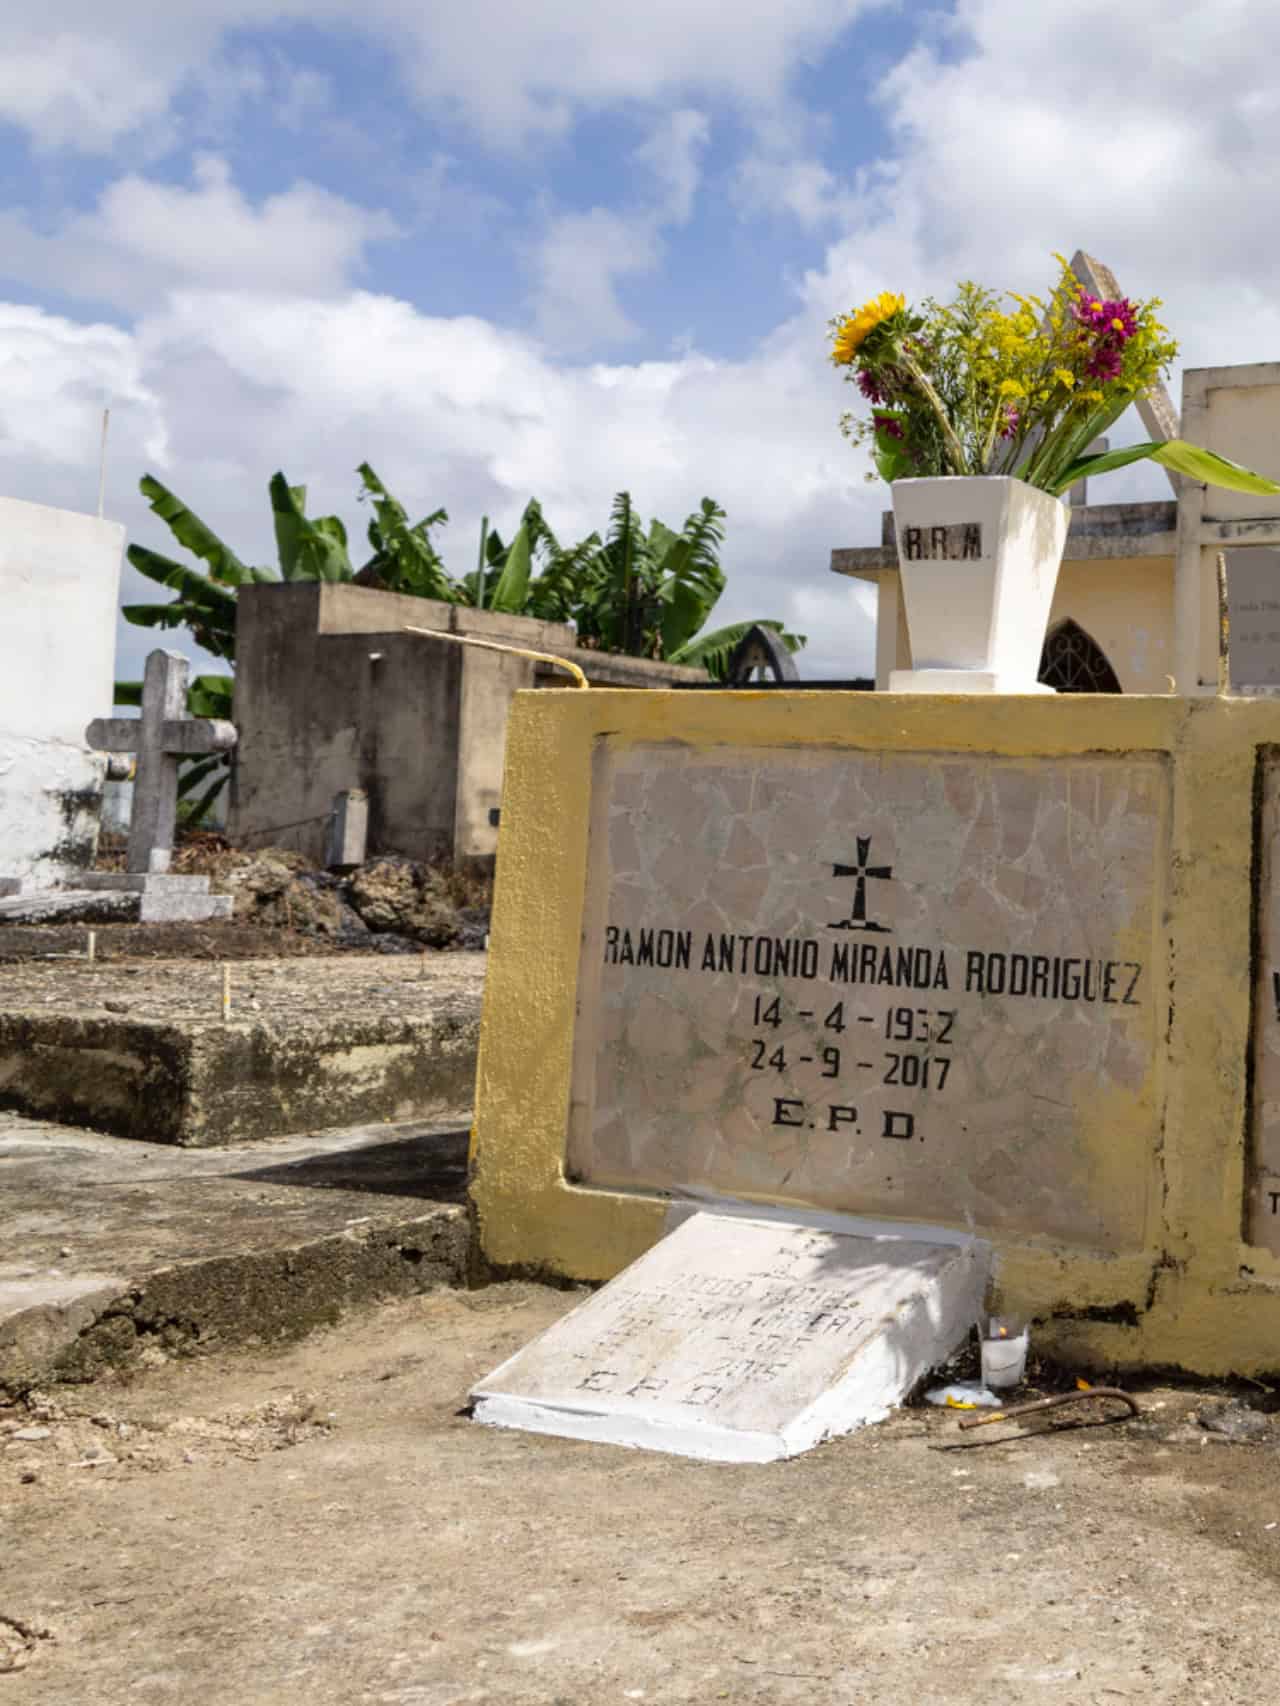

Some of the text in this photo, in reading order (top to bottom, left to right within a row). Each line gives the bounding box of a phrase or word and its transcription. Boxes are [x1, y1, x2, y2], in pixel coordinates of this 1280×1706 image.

[603, 925, 1141, 1005] RAMON ANTONIO MIRANDA RODRIGUEZ
[882, 1053, 951, 1091] 2017
